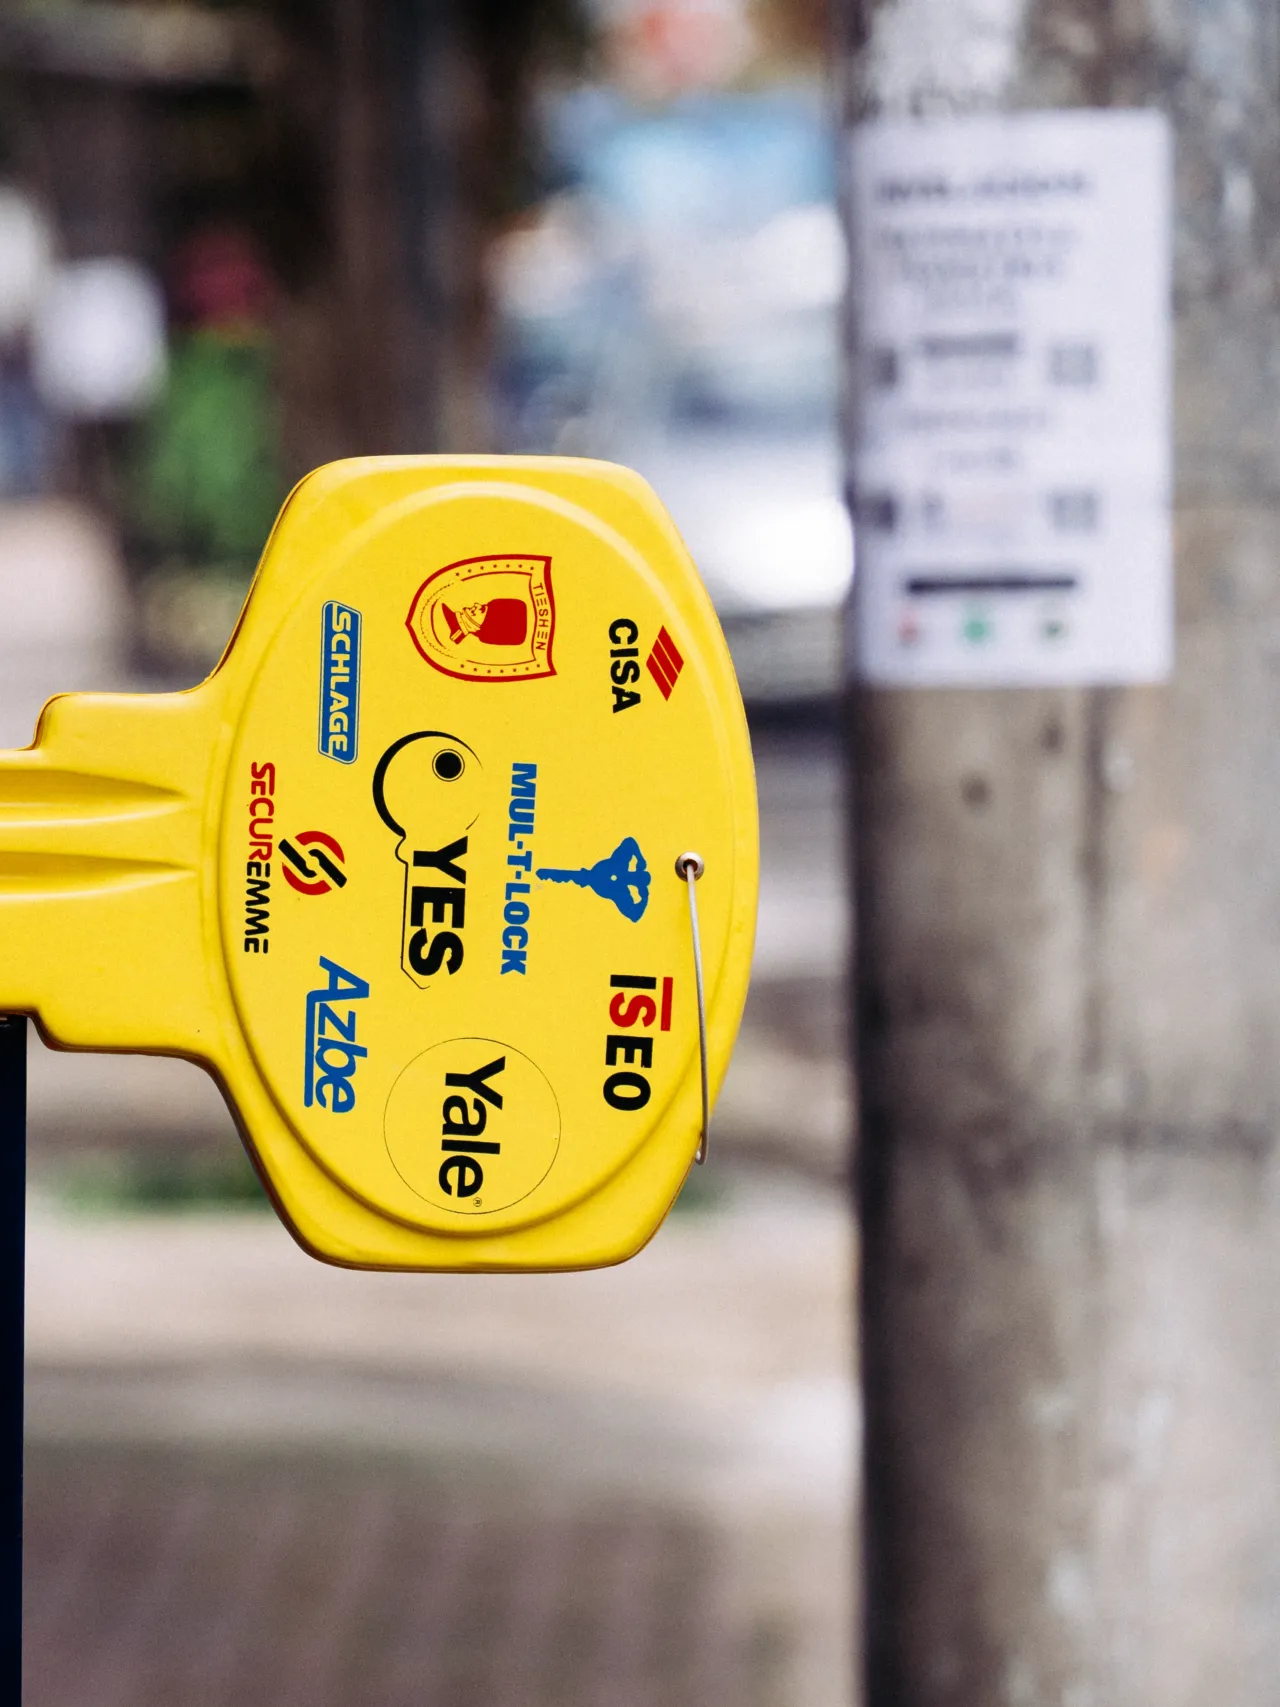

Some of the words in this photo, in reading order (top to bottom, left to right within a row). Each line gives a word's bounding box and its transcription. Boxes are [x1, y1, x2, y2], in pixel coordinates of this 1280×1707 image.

[327, 605, 352, 756] SCHLAGE
[533, 582, 549, 651] TIESHEN
[609, 618, 641, 713] CISA
[244, 762, 276, 953] SECUREMME
[408, 836, 468, 976] YES
[501, 763, 537, 975] MUL-T-LOCK
[305, 955, 370, 1113] Azbe
[603, 974, 657, 1111] ISEO
[438, 1056, 506, 1198] Yale
